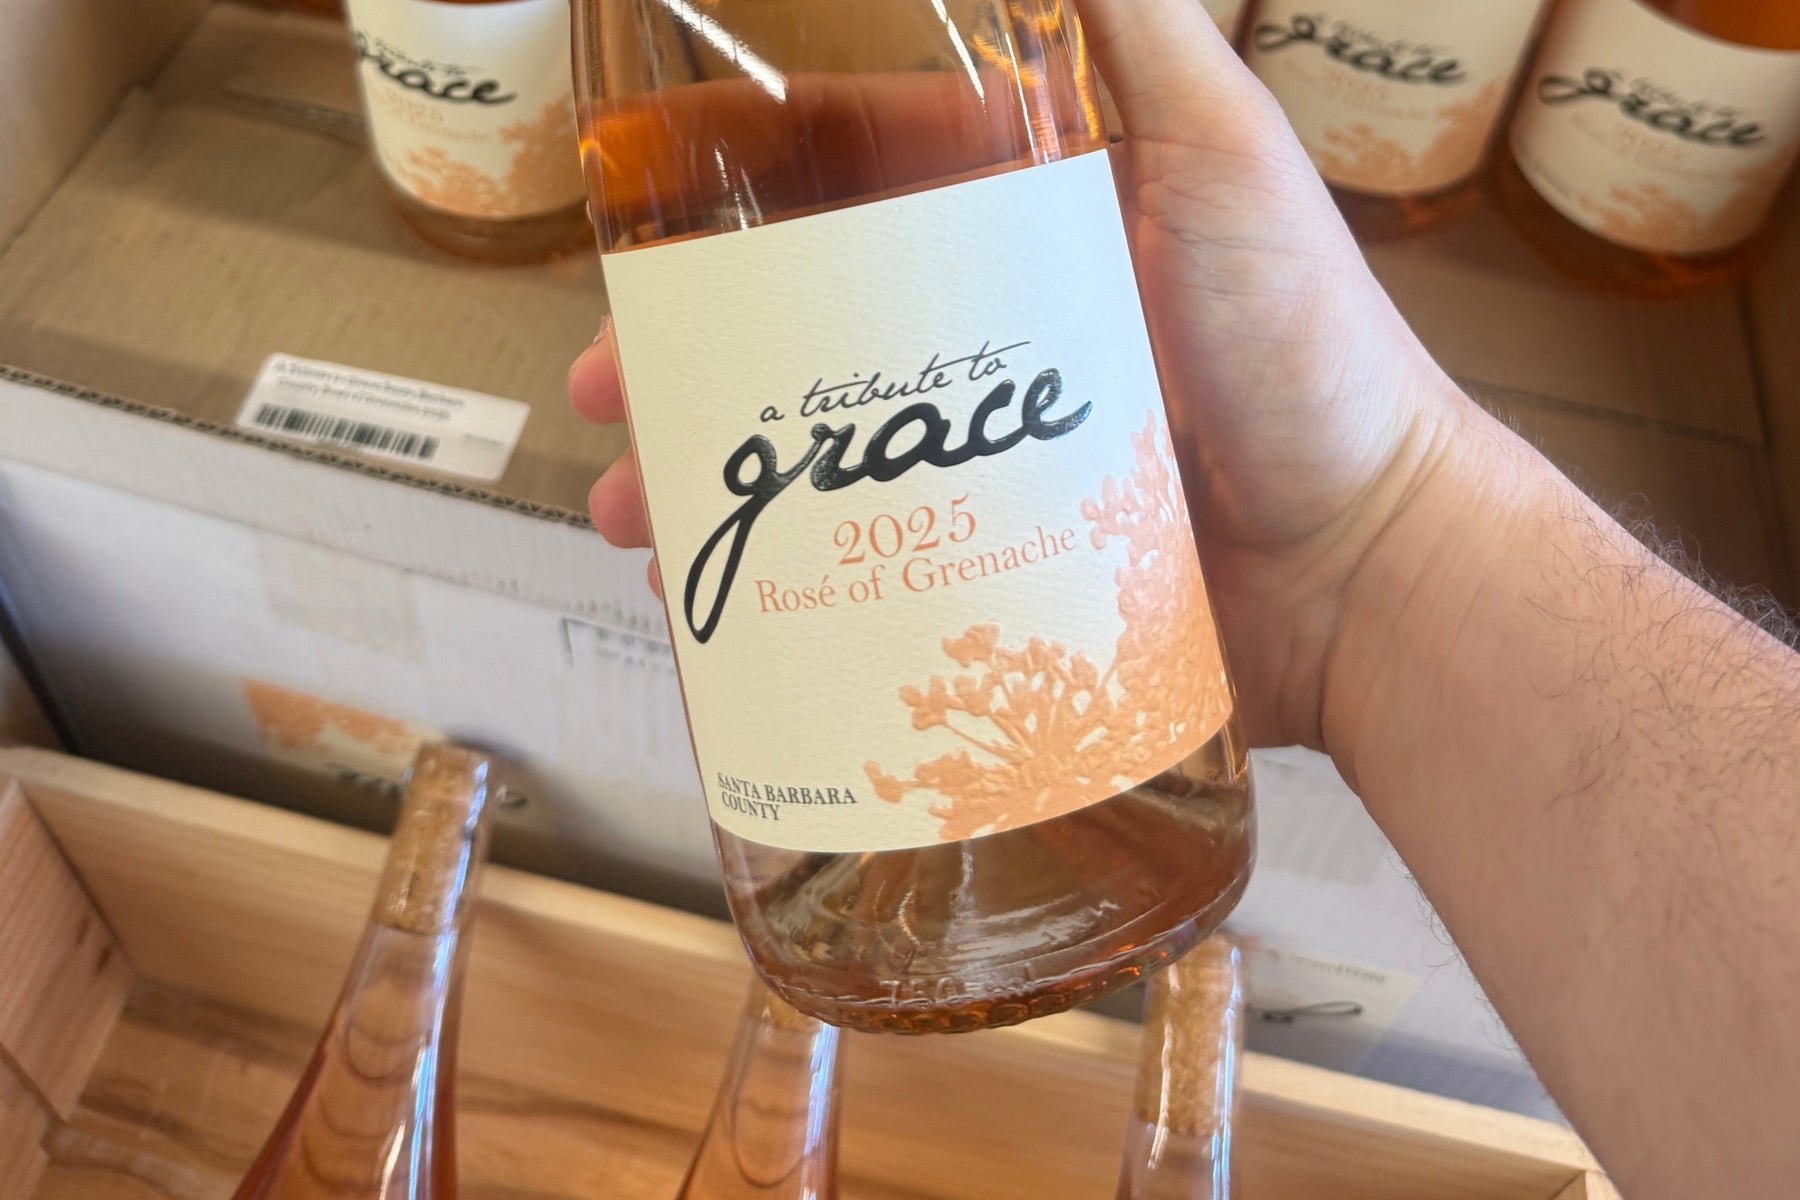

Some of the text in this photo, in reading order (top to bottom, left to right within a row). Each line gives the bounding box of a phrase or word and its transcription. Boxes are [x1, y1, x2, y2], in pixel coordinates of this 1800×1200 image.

[1253, 13, 1468, 85] grace
[1537, 68, 1768, 148] grace
[759, 340, 1032, 423] a tribute to
[684, 366, 1094, 645] grace
[832, 491, 977, 566] 2025
[755, 524, 1078, 614] Rosé of Grenache
[717, 772, 858, 805] SANTA BARBARA
[721, 791, 781, 821] COUNTY
